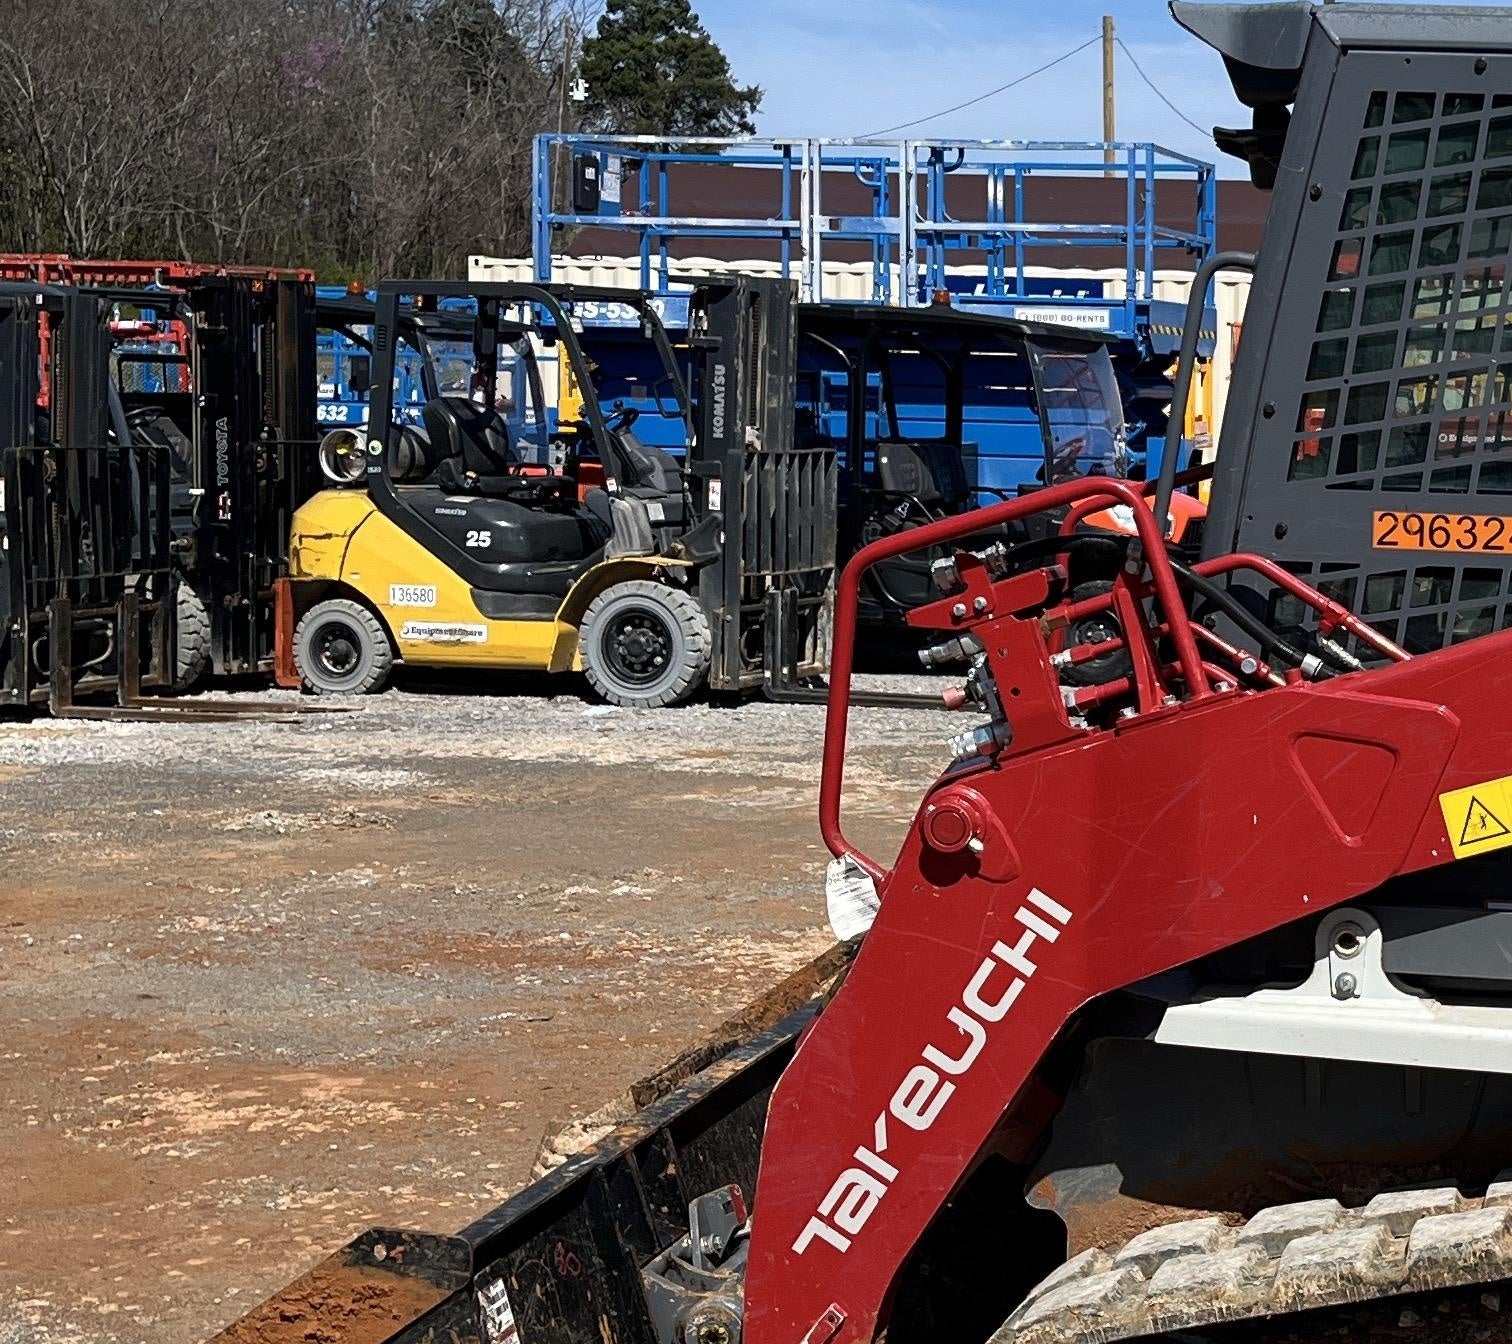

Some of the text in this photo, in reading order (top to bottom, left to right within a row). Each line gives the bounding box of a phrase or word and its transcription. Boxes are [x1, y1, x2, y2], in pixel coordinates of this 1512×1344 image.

[711, 364, 726, 439] KOMATSU
[215, 416, 229, 486] TOYOTA
[465, 530, 492, 548] 25
[390, 587, 435, 604] 136580
